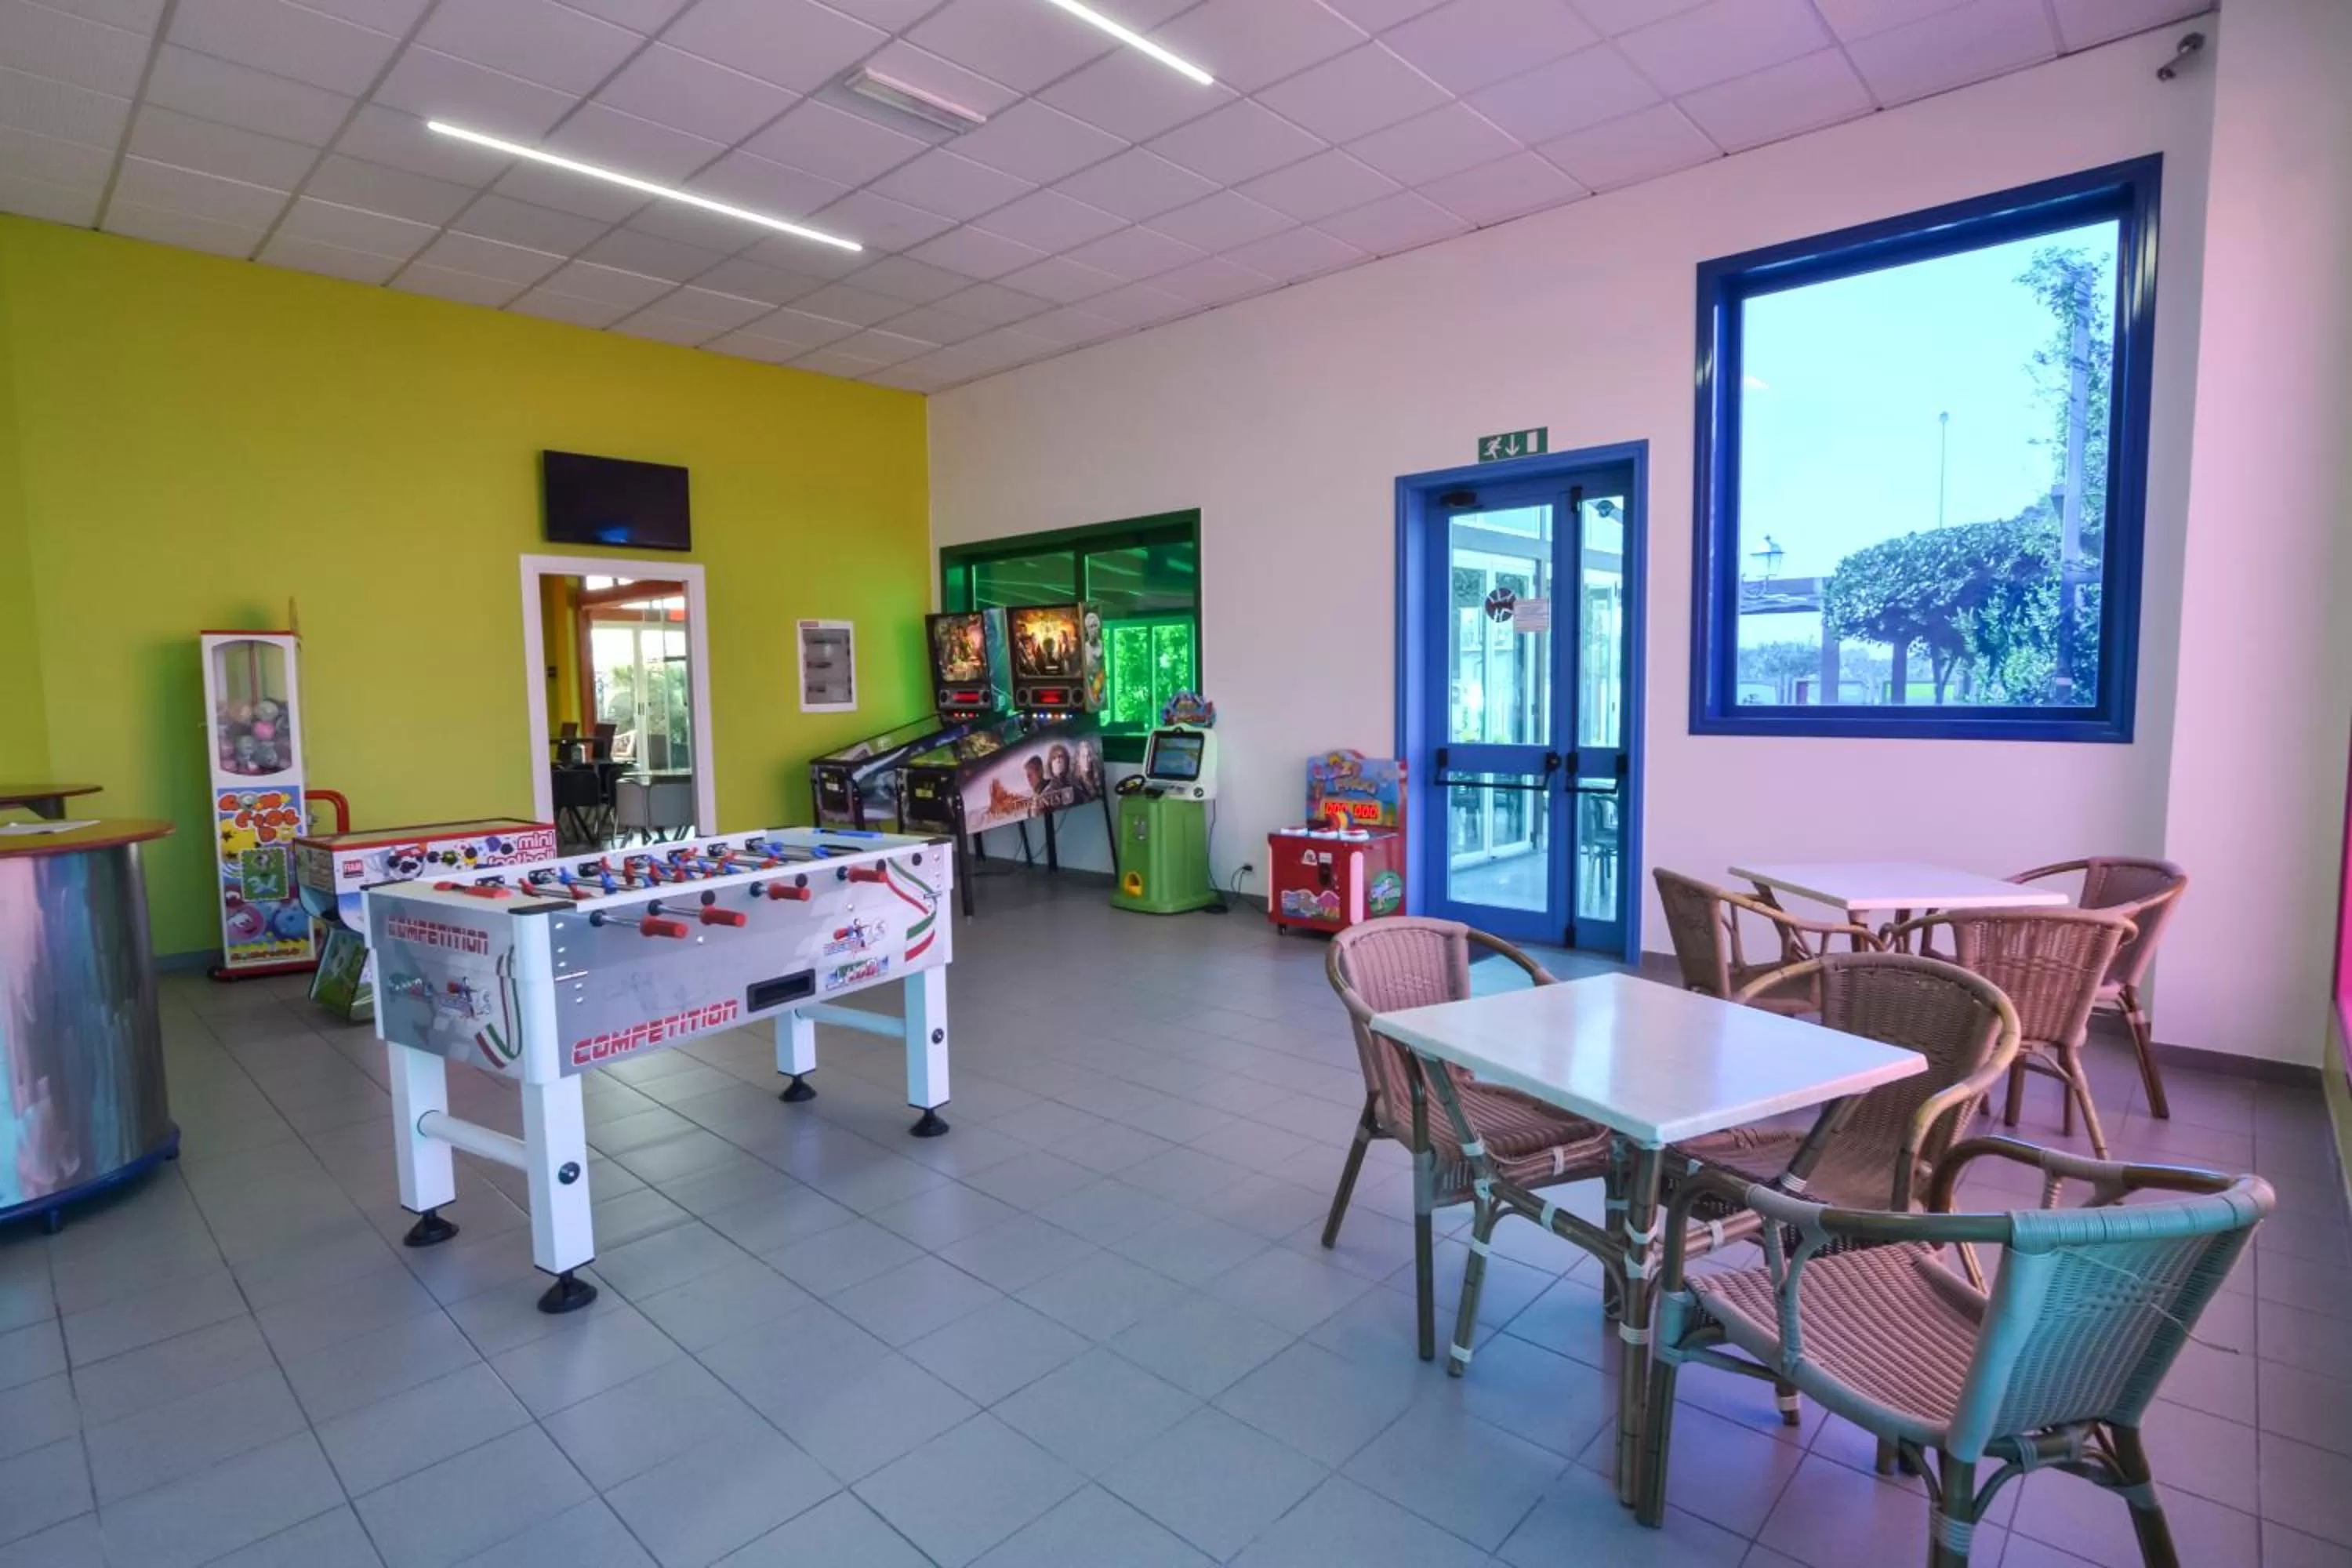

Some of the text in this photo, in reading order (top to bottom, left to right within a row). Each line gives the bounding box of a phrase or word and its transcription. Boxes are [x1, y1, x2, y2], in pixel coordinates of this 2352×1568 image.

[517, 831, 554, 850] mini
[387, 915, 489, 956] COMPETITION
[572, 998, 739, 1066] COMPETITION
